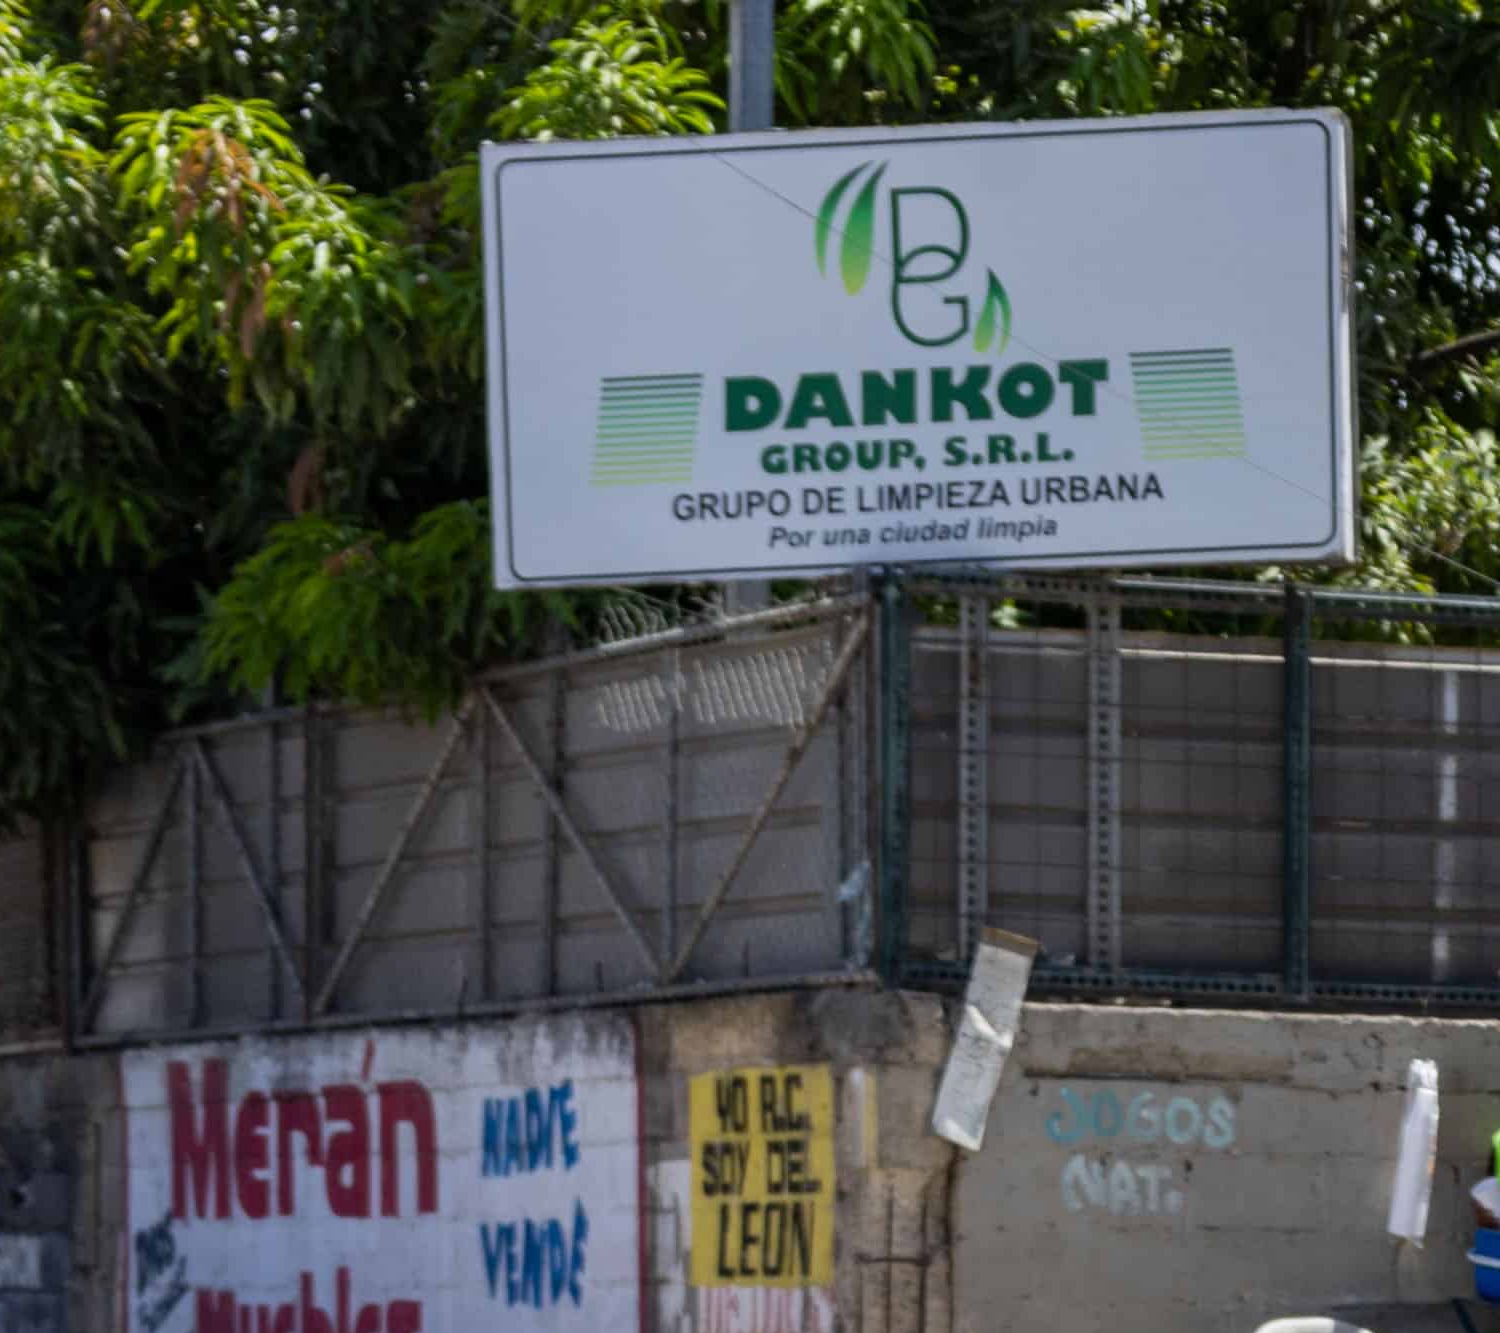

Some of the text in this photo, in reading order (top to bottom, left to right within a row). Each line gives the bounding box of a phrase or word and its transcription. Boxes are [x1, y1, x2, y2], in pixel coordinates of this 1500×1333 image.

[725, 359, 1109, 431] DANKOT
[760, 432, 1075, 474] GROUP, S.R.L.
[672, 473, 1165, 521] GRUPO DE LIMPIEZA URBANA
[768, 514, 1059, 549] Por una ciudad limpia
[165, 1039, 438, 1223] Merán
[481, 1078, 580, 1178] NADIE
[716, 1075, 748, 1133] YO
[702, 1141, 749, 1196] SOY
[1060, 1153, 1184, 1216] NAT.
[718, 1202, 814, 1277] LEON
